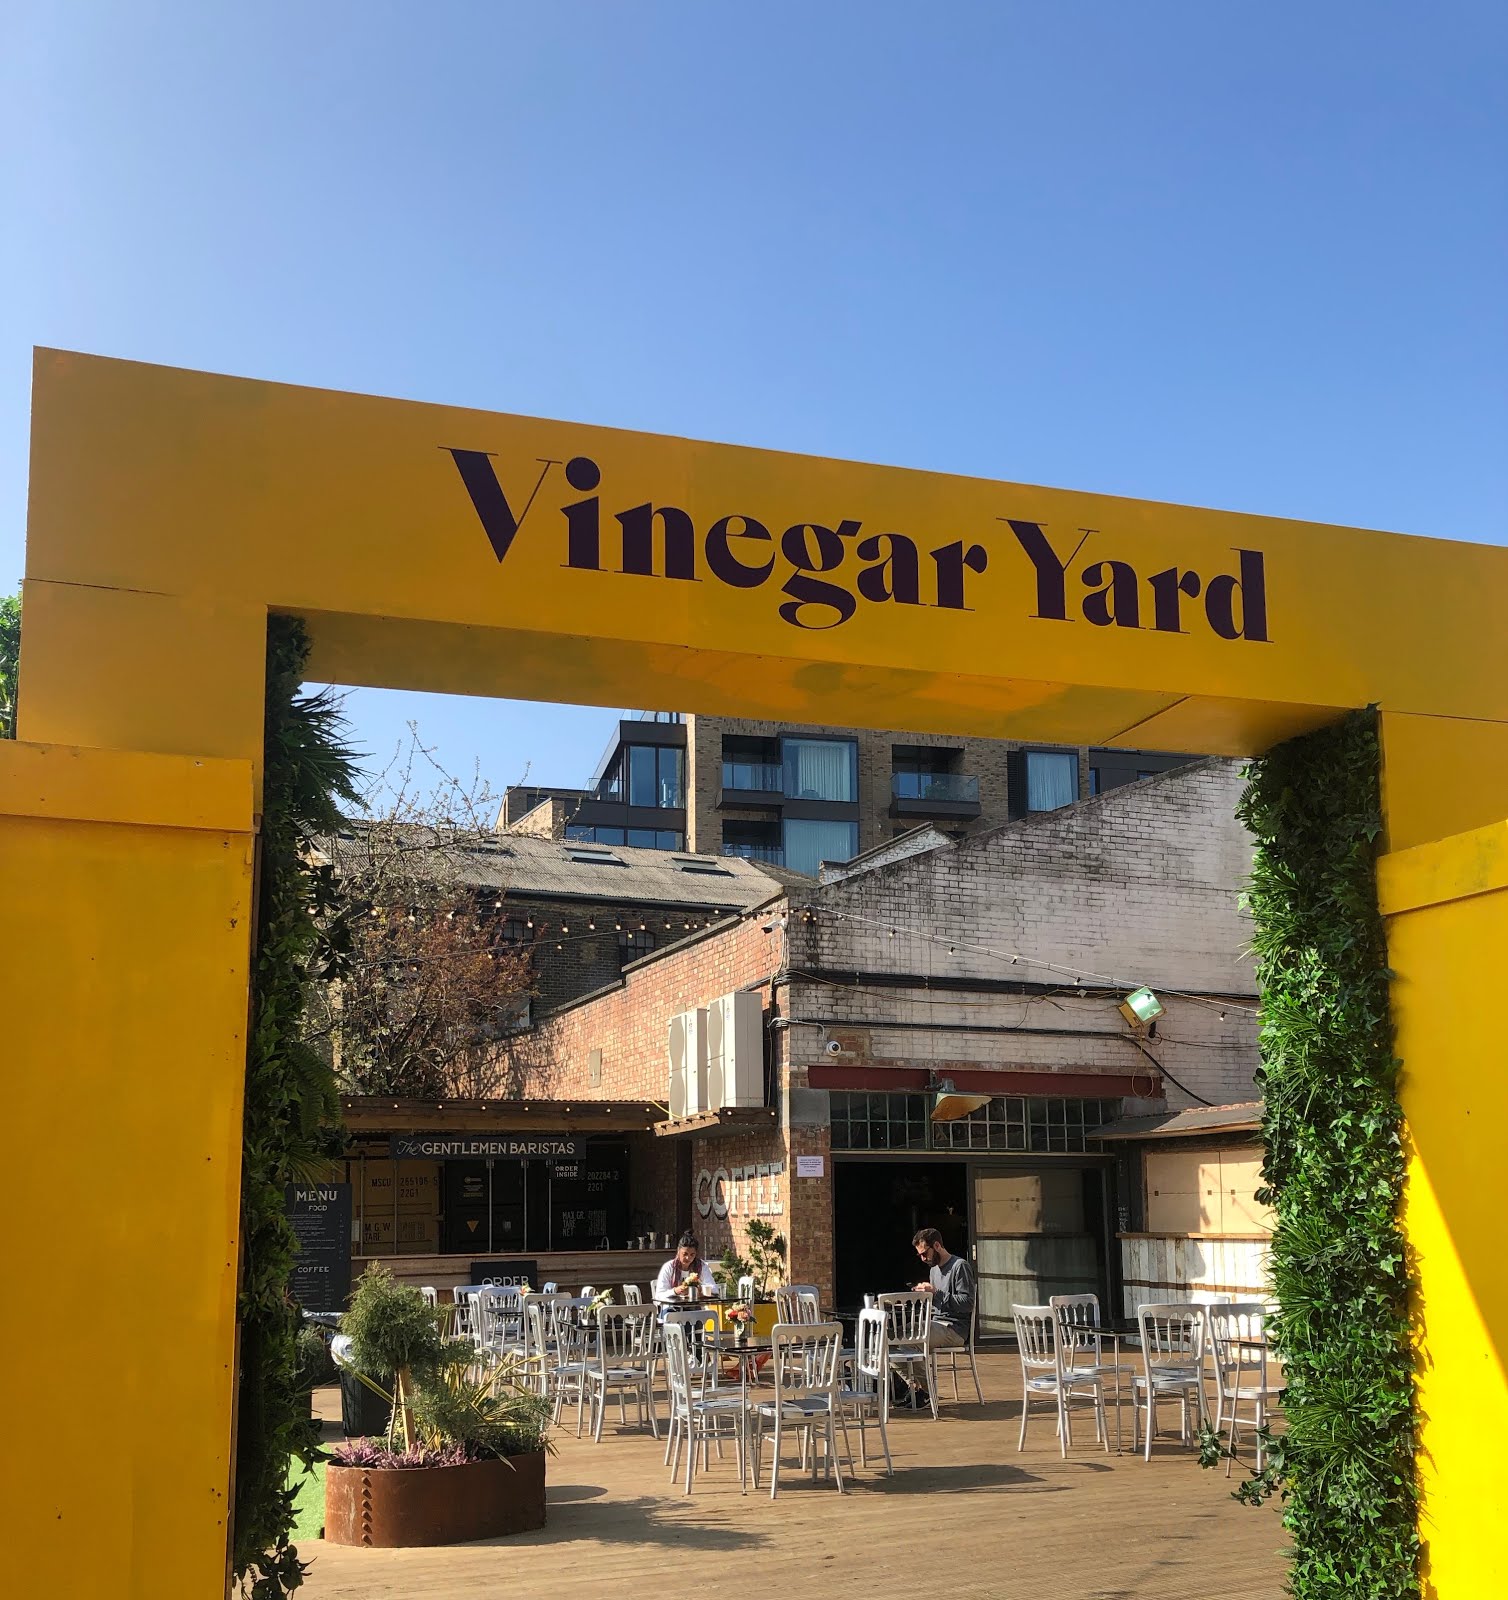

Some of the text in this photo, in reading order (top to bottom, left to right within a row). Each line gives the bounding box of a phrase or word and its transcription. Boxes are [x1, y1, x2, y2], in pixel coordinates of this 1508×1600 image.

[438, 446, 1275, 644] Vinegar Yard
[396, 1139, 576, 1156] The GENTLEMEN BARISTAS
[296, 1190, 338, 1202] MENU
[695, 1162, 784, 1220] COFFEE
[482, 1275, 529, 1287] ORDER
